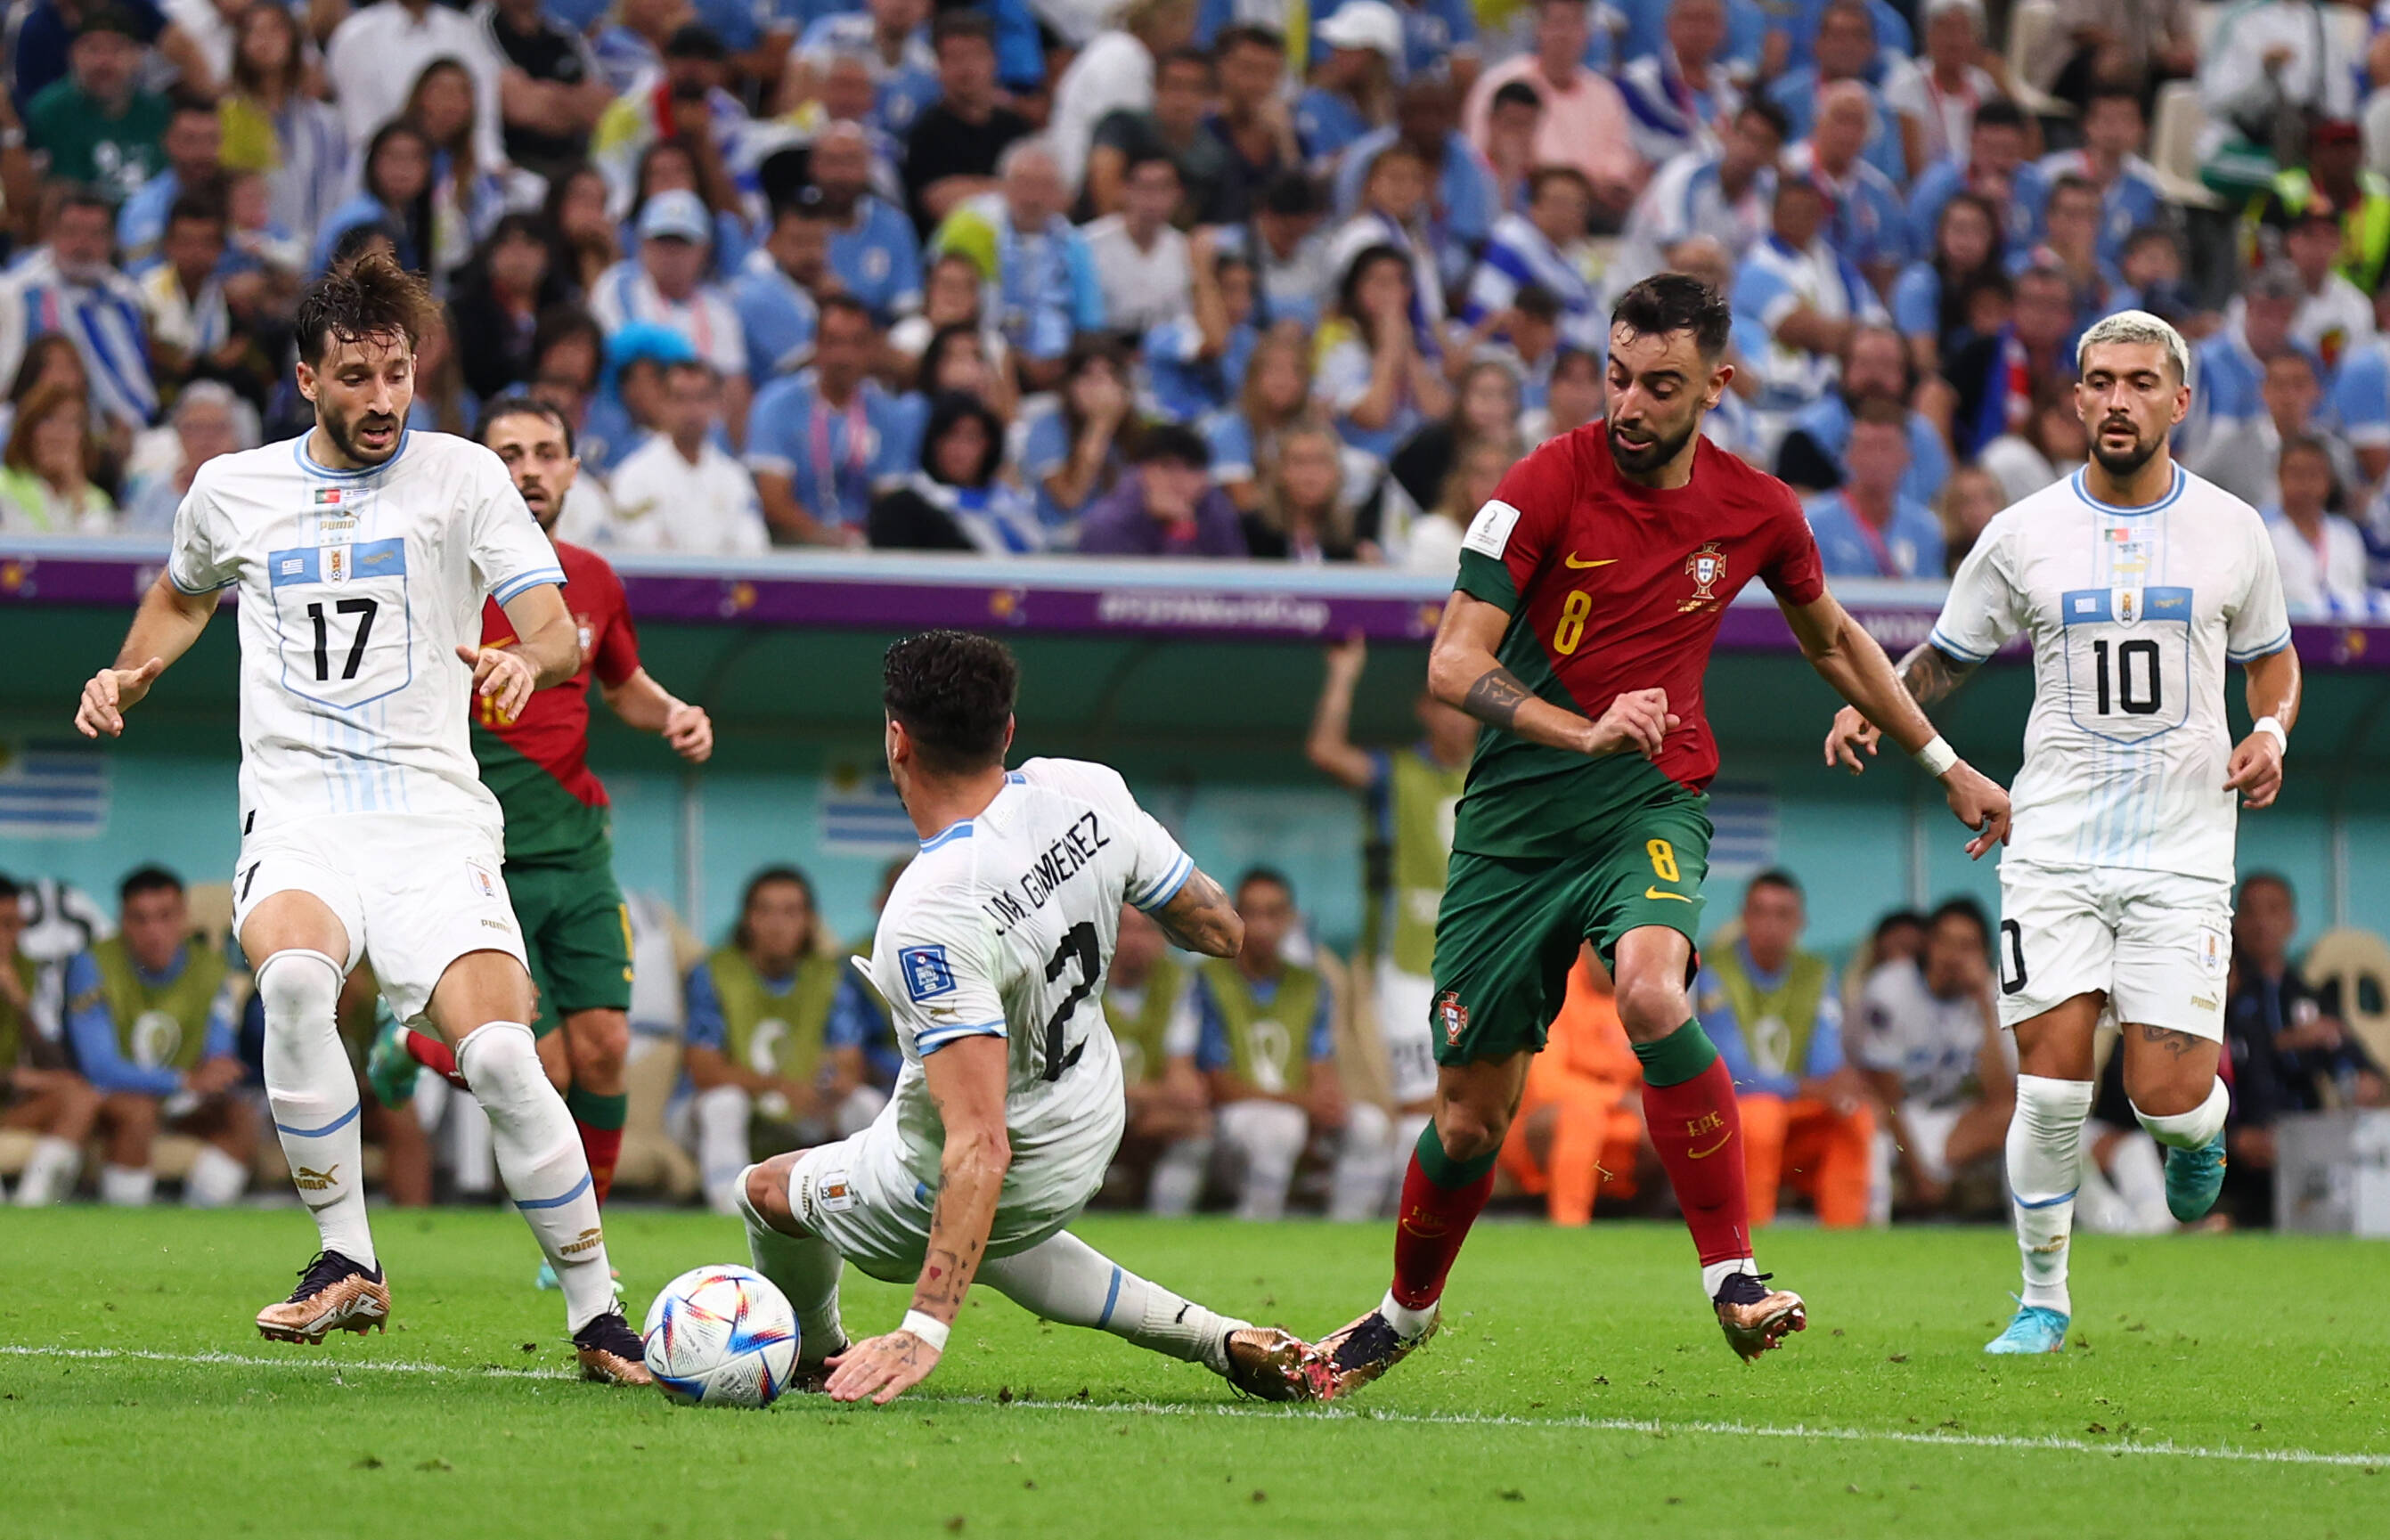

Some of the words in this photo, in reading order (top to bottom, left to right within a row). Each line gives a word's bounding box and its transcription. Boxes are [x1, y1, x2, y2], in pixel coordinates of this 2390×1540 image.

[307, 598, 379, 680] 17
[1554, 590, 1593, 655] 8
[2094, 640, 2161, 715] 10
[1021, 811, 1111, 909] GIMÉNEZ
[1646, 838, 1681, 883] 8
[1042, 921, 1100, 1082] 2
